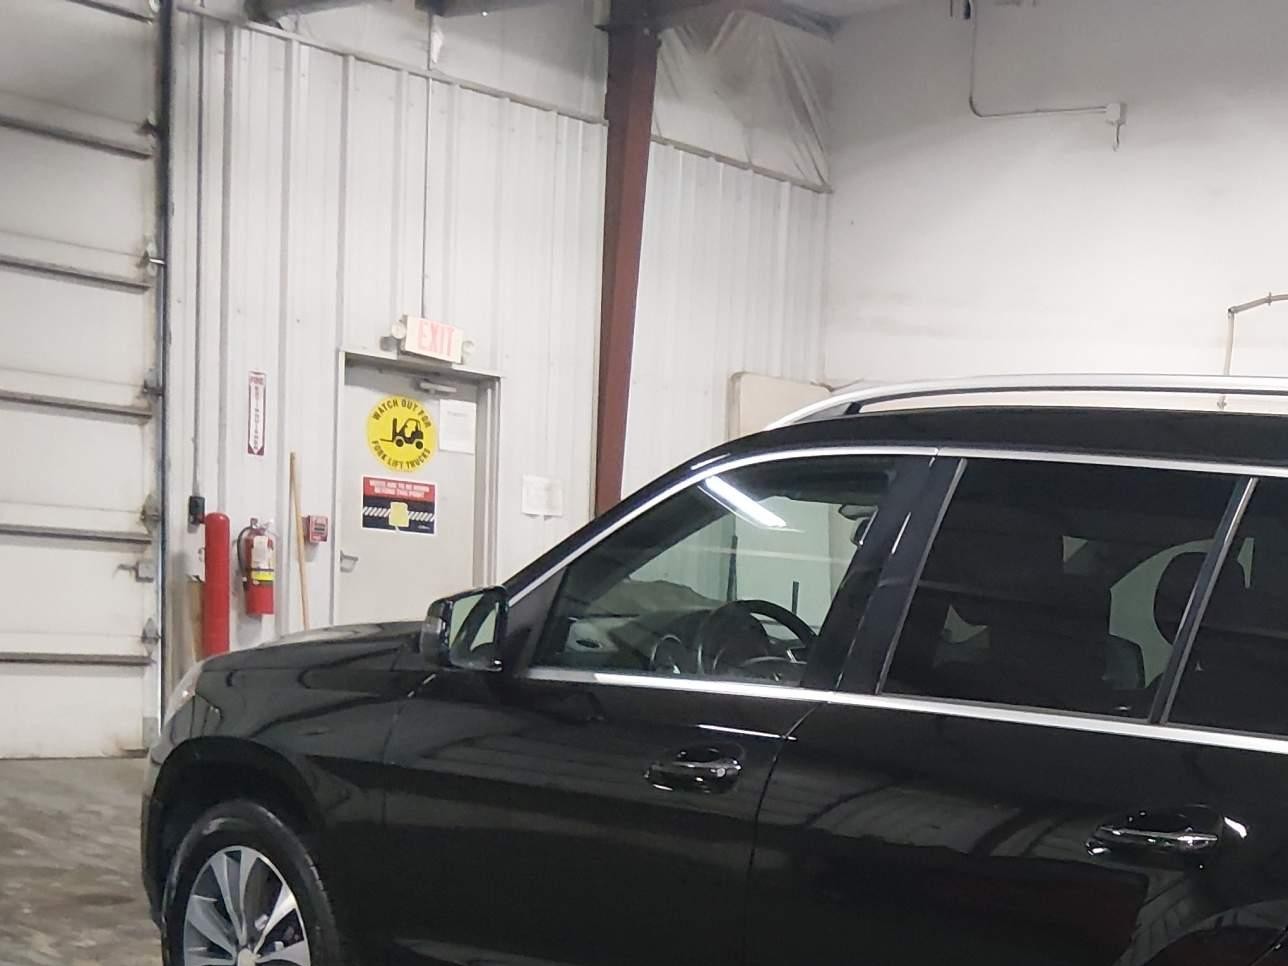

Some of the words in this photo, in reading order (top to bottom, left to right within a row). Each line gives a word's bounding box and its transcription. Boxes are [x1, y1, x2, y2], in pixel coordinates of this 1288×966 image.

[417, 319, 455, 356] EXIT
[372, 399, 399, 420] WATCH
[401, 399, 418, 412] OUT
[417, 409, 432, 429] FOR
[371, 440, 388, 460] FORK
[387, 458, 404, 470] LIFT
[405, 448, 431, 469] TRUCKS
